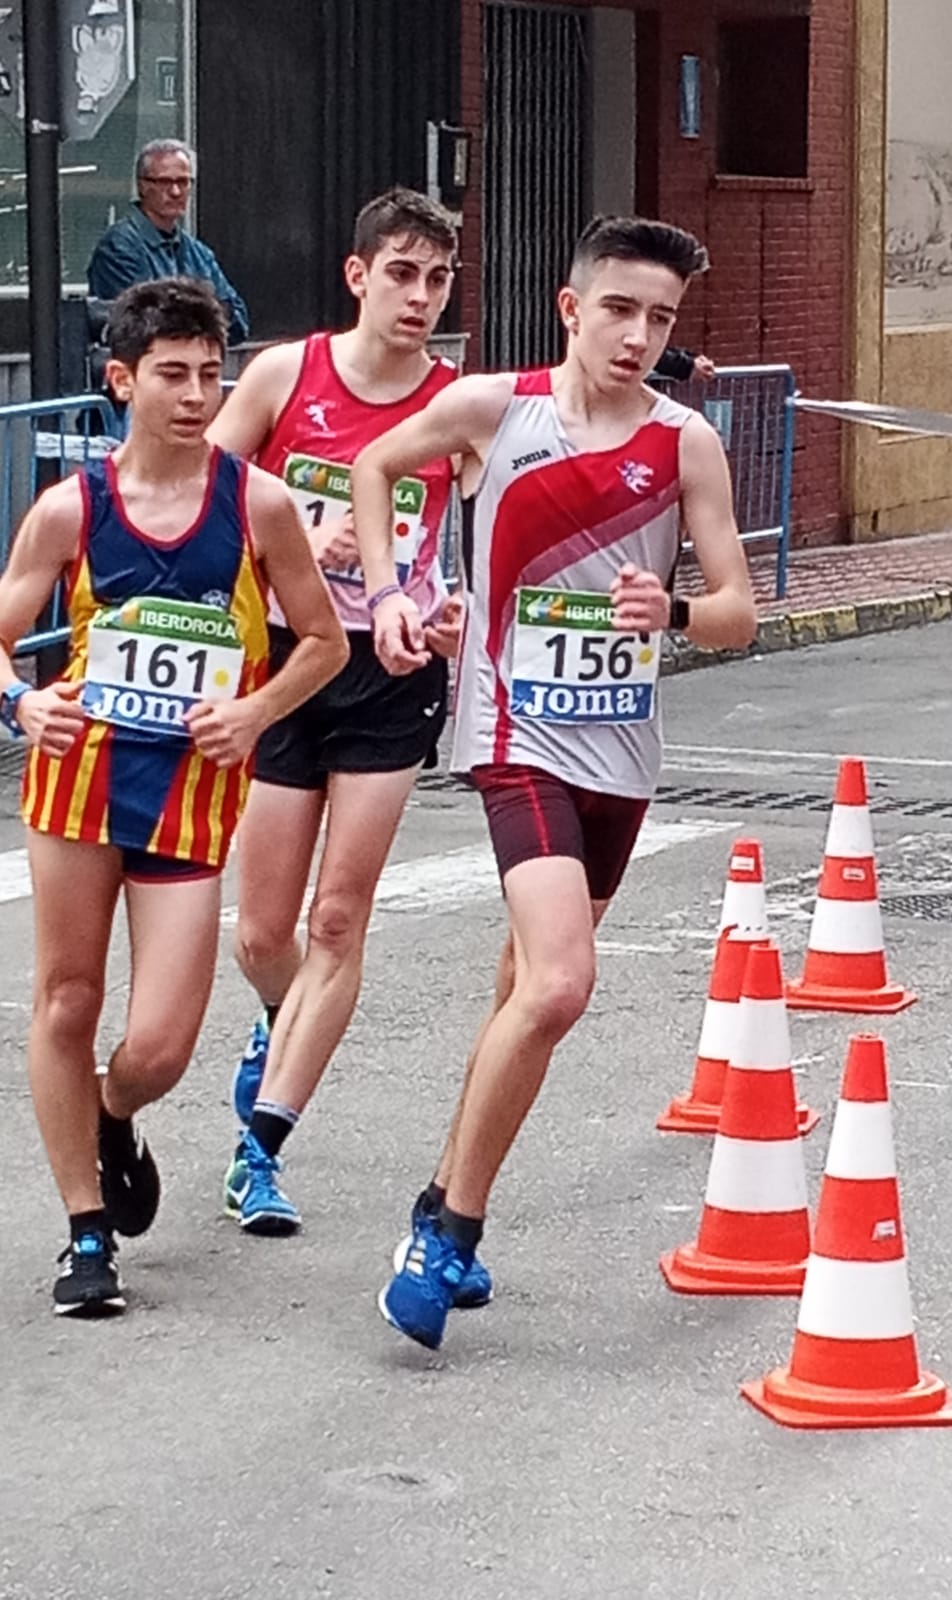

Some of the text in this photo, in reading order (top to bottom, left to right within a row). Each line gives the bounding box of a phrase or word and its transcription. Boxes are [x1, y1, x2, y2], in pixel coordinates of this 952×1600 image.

[140, 609, 237, 639] IBERDROLA
[565, 604, 618, 621] IBERD
[117, 638, 208, 693] 161
[545, 633, 636, 681] 156
[90, 687, 186, 726] Jom
